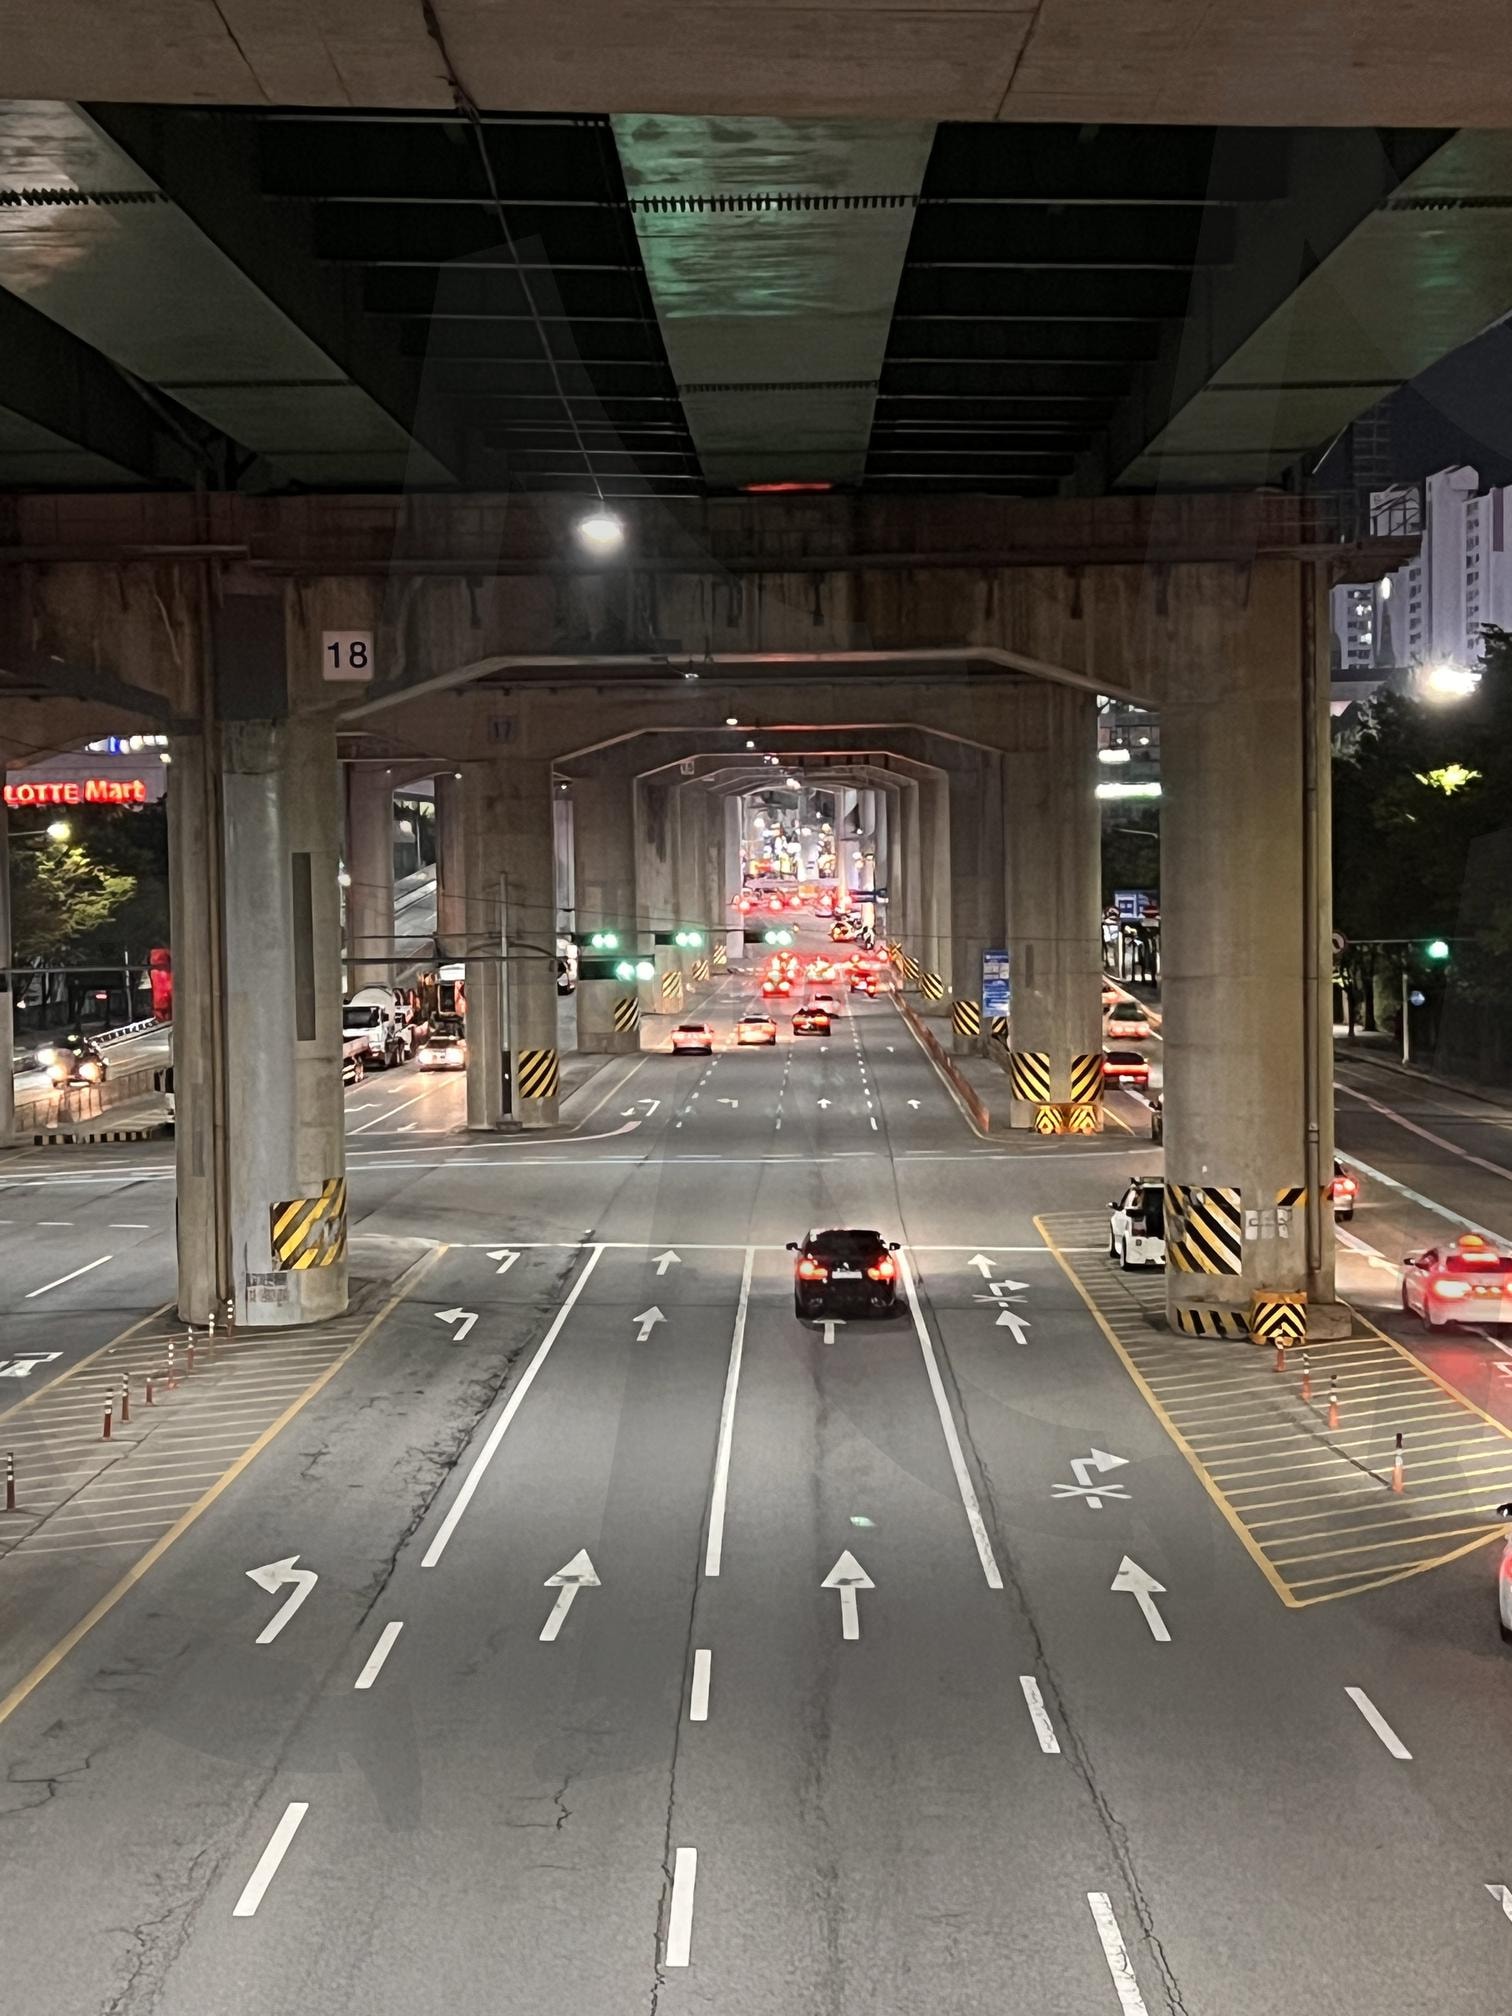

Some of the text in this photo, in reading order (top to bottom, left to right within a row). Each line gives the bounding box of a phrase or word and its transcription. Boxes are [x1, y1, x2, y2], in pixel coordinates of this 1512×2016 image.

[327, 641, 368, 669] 18
[3, 778, 146, 804] LOTTE Mart
